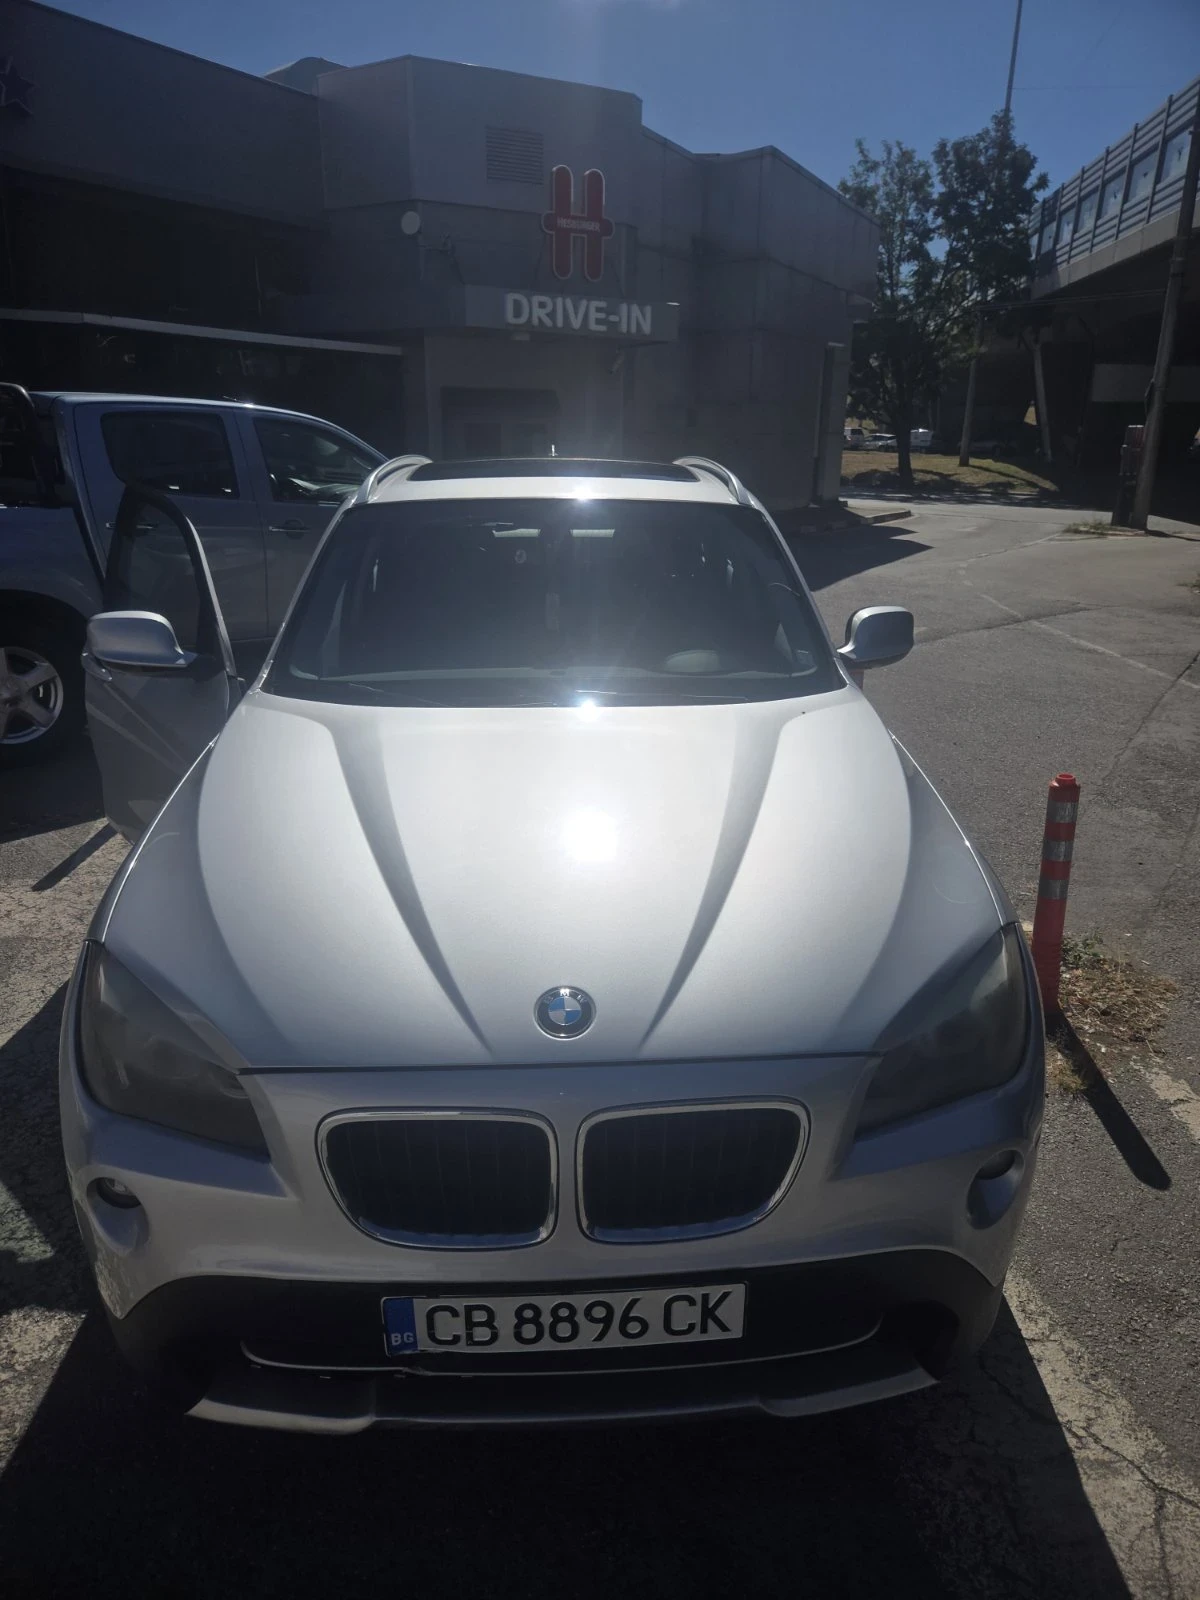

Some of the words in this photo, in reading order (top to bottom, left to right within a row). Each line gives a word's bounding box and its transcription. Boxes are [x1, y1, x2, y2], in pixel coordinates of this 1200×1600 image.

[541, 165, 615, 282] H
[505, 292, 652, 335] DRIVE-IN
[391, 1332, 415, 1346] BG
[426, 1304, 499, 1347] CB
[513, 1298, 650, 1346] 8896
[663, 1290, 733, 1337] CK
